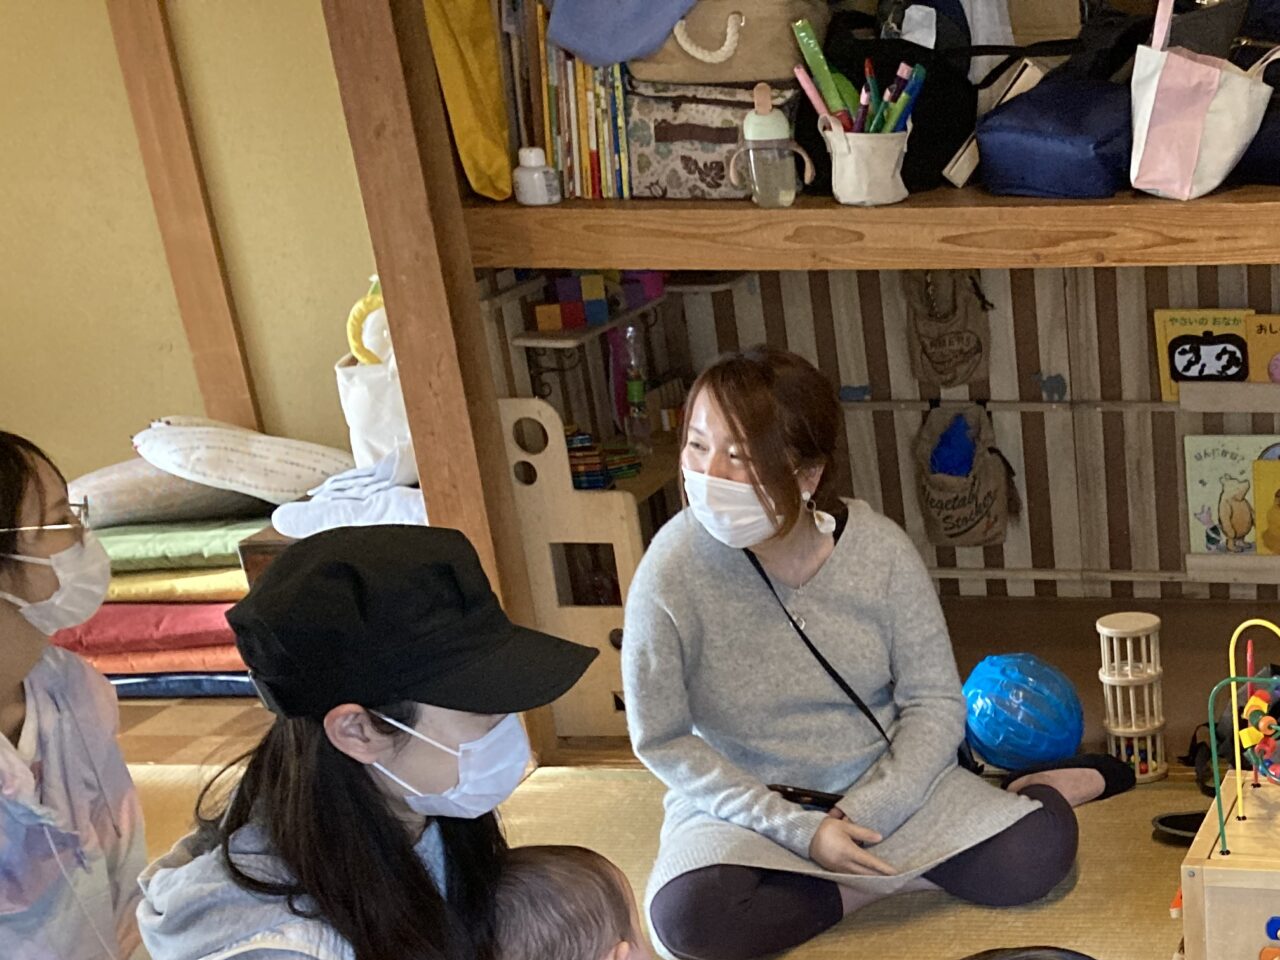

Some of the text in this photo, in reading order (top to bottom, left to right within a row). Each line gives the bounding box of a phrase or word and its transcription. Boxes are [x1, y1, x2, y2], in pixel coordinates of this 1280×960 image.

[1169, 316, 1242, 327] やさいの おなか
